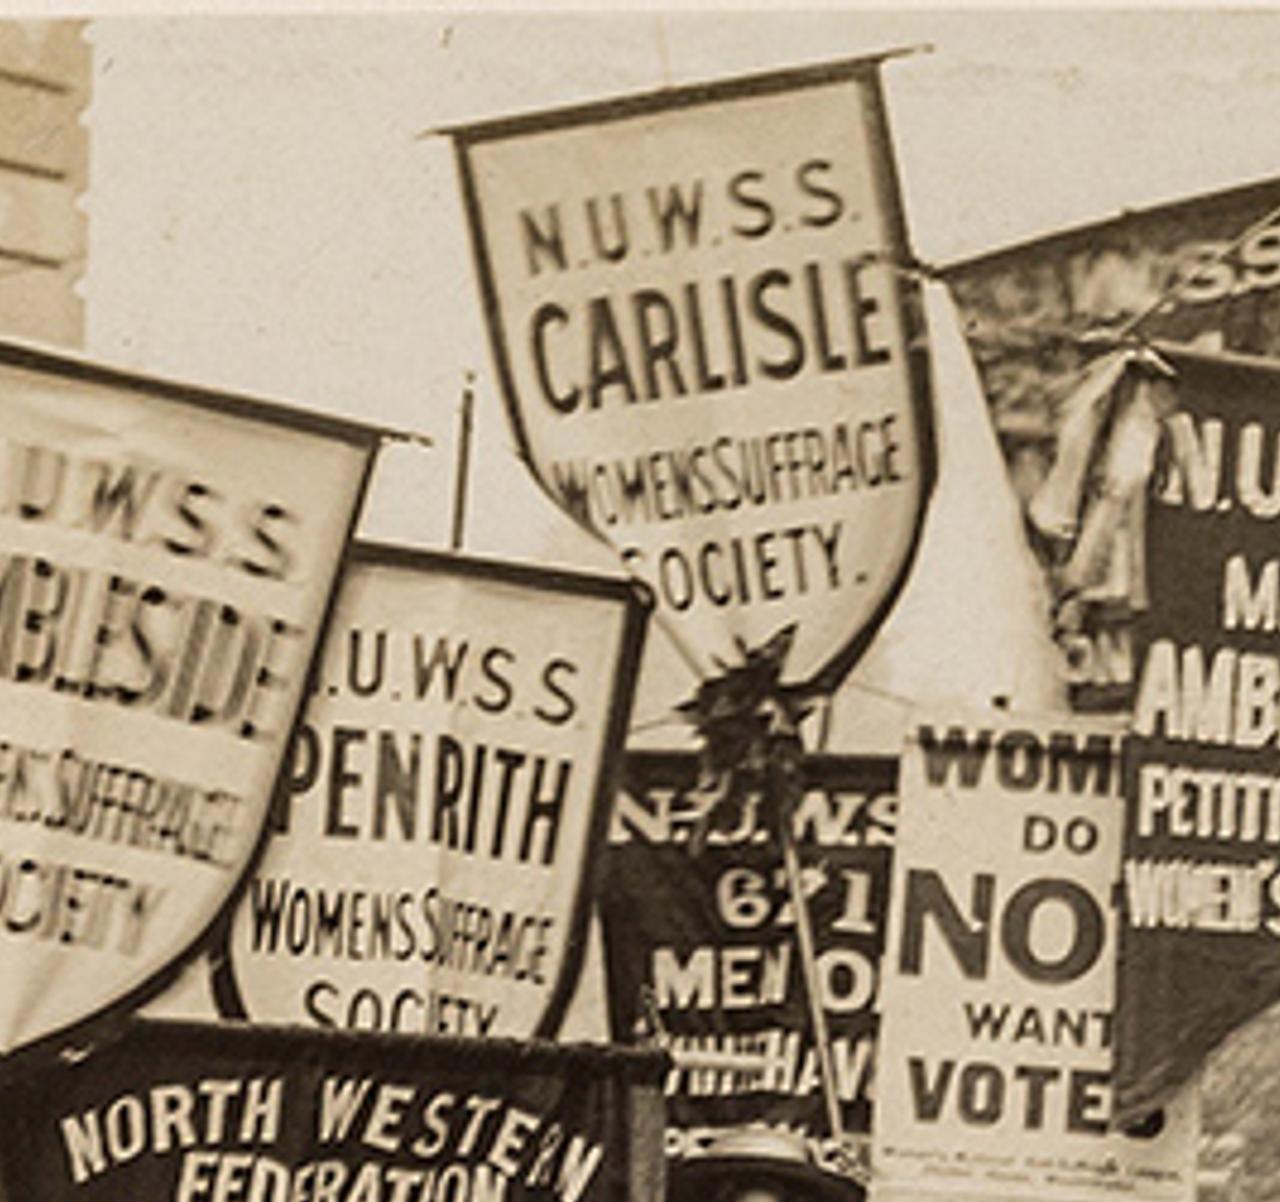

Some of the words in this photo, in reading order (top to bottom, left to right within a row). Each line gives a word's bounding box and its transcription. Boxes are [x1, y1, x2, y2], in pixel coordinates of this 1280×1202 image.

[531, 251, 890, 414] CARLISLE
[622, 522, 868, 611] OCIETY.
[272, 723, 573, 866] PENRITH
[1023, 816, 1098, 854] DO
[899, 869, 1118, 984] NO
[652, 941, 792, 1010] MEN
[818, 949, 882, 1014] O
[966, 1003, 1113, 1047] WANT
[61, 1077, 284, 1184] NORTH
